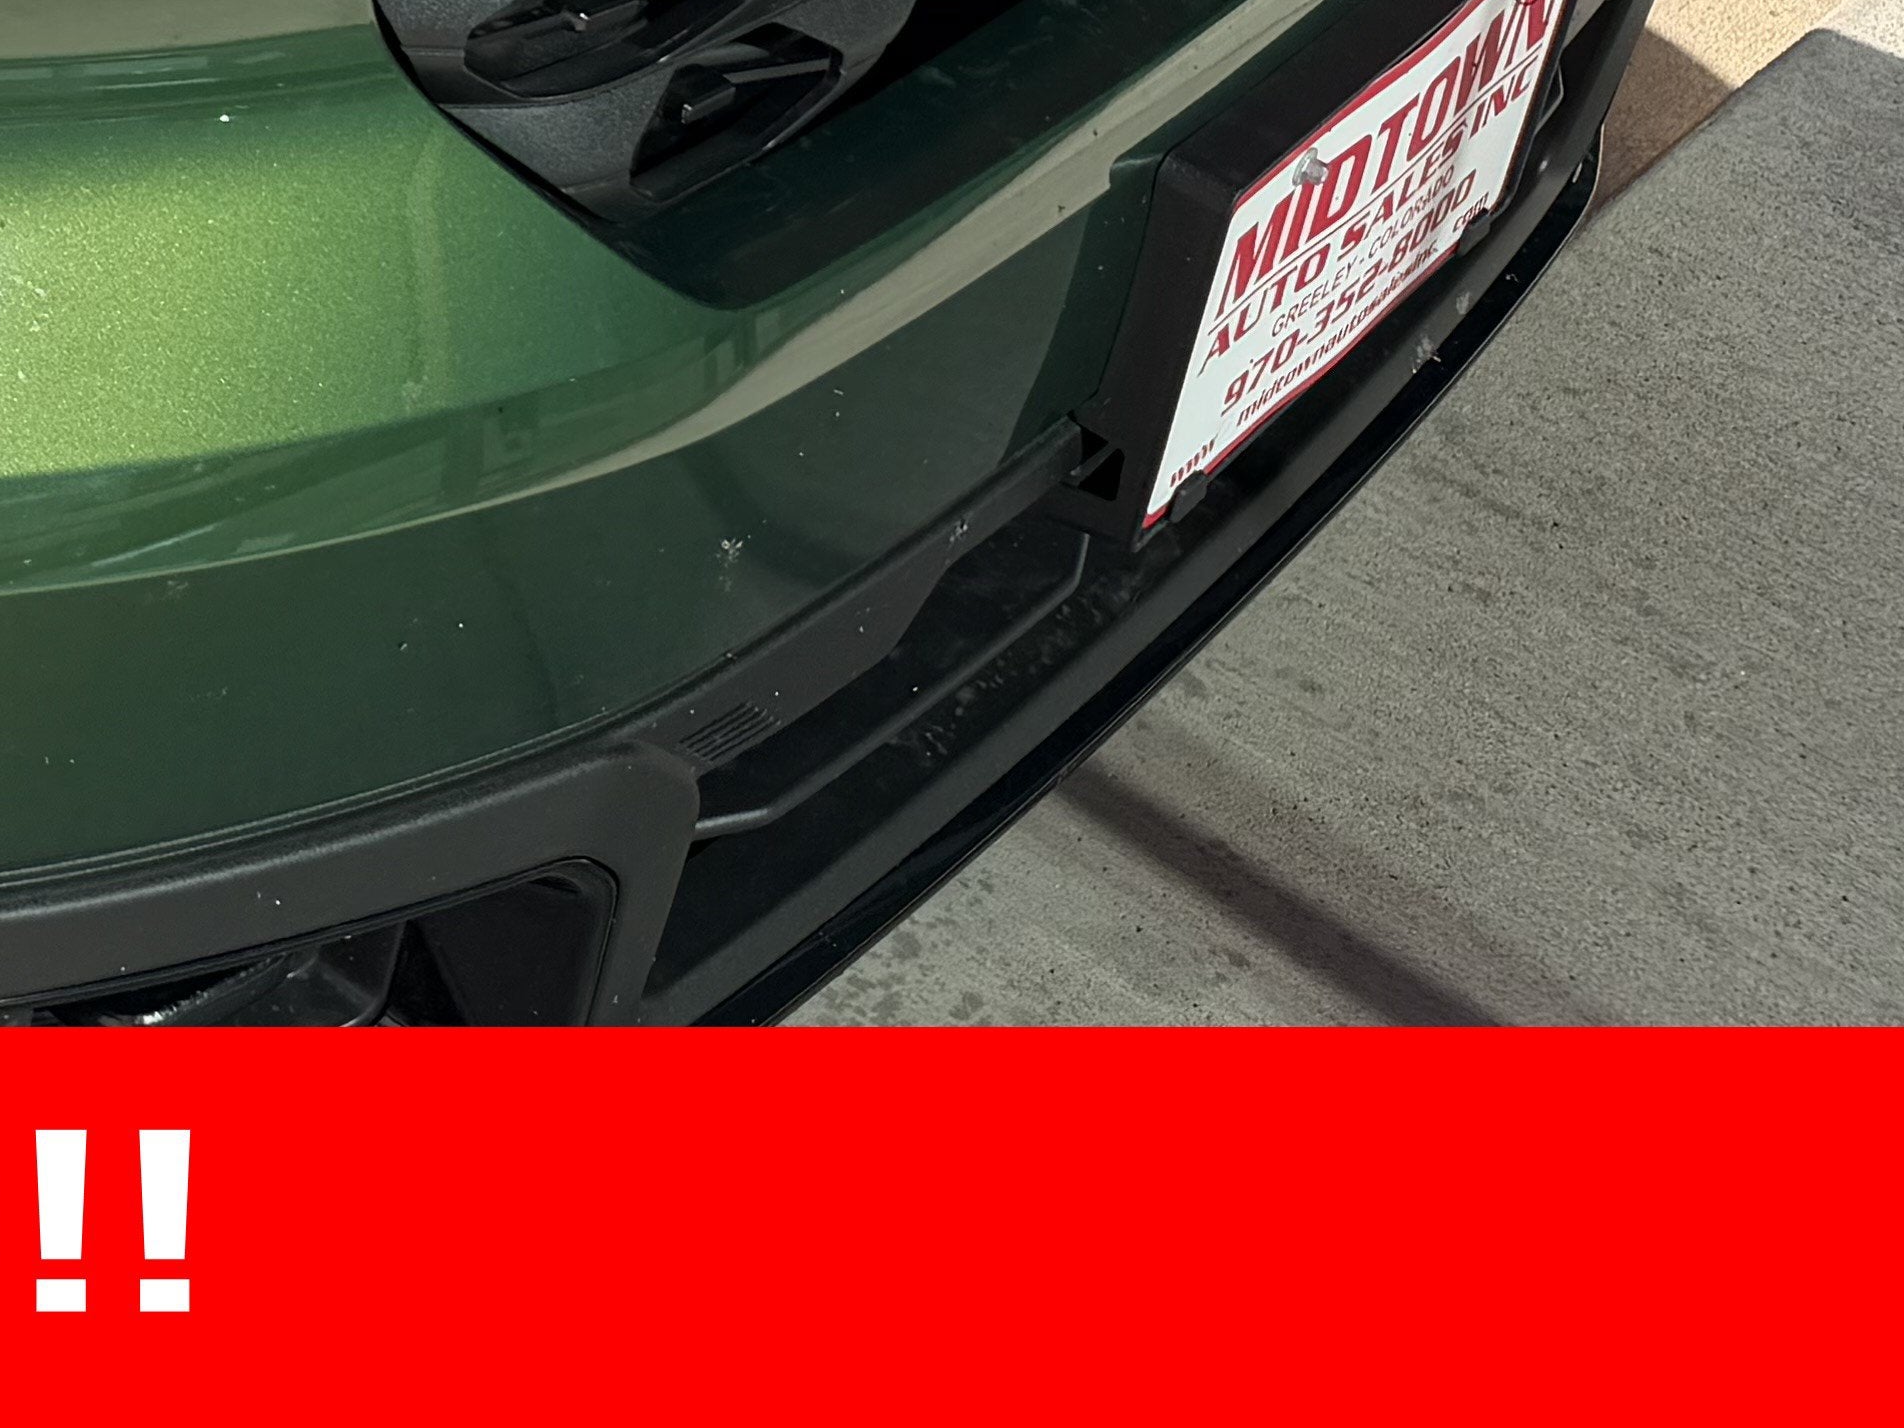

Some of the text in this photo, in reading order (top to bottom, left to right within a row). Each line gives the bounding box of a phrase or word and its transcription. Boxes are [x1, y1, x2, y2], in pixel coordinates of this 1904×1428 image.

[1196, 54, 1539, 378] AUTO SALES INC
[1220, 167, 1477, 418] 970-352-8000
[1271, 255, 1358, 338] GREELEY
[1368, 164, 1455, 259] COLORADO
